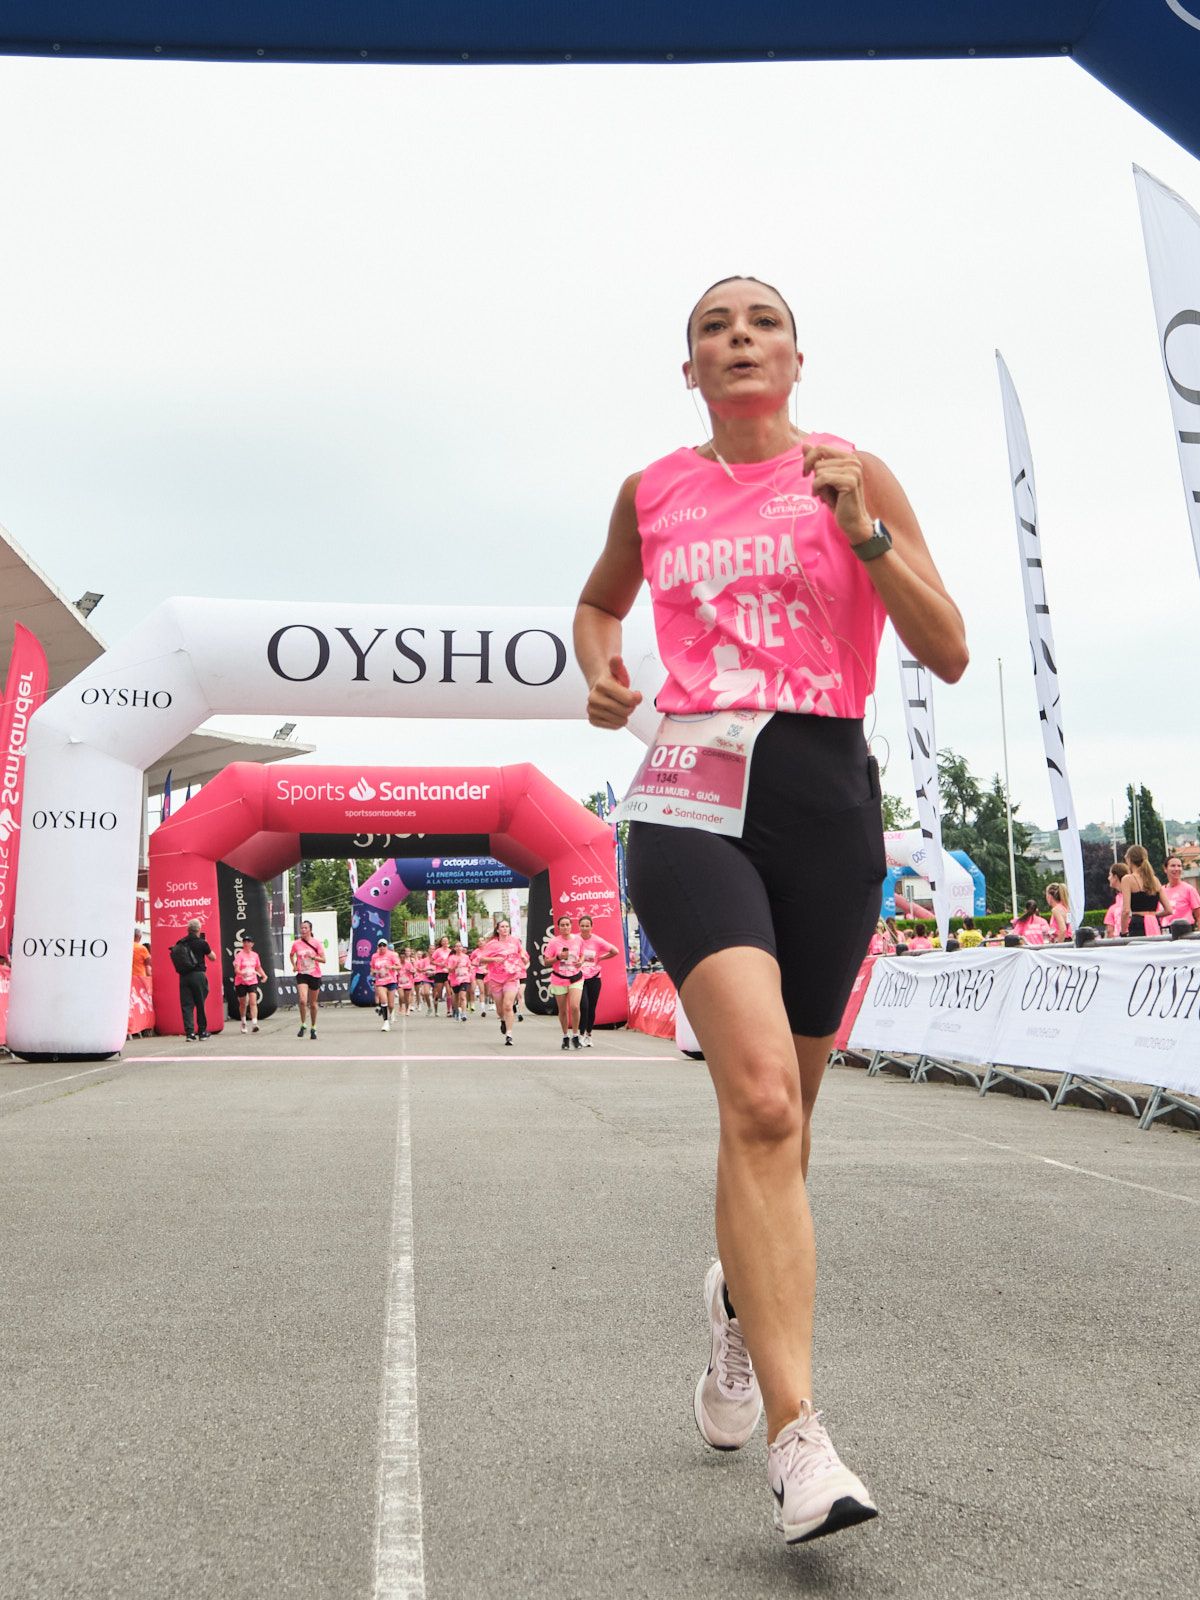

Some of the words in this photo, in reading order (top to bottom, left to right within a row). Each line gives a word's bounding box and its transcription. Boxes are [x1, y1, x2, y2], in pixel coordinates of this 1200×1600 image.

[658, 533, 800, 591] CARRERA
[736, 591, 785, 648] DE
[267, 624, 567, 687] OYSHO
[81, 688, 173, 709] OYSHO
[650, 745, 698, 769] 016
[656, 773, 678, 784] 1345
[276, 780, 345, 805] Sports
[380, 781, 491, 801] Santander
[646, 785, 655, 793] DE
[656, 786, 664, 794] LA
[664, 786, 690, 797] MUJER
[696, 790, 720, 803] GIJÓN
[32, 810, 118, 831] OYSHO
[345, 809, 417, 818] sportssantander.es
[674, 808, 724, 824] Santander
[443, 858, 478, 868] octopus
[166, 881, 199, 893] Sports
[571, 874, 602, 886] Sports
[164, 897, 212, 909] Santander
[233, 877, 247, 920] Deporte
[570, 889, 616, 902] Santander
[23, 938, 108, 958] OYSHO
[1021, 965, 1100, 1013] OYSHO
